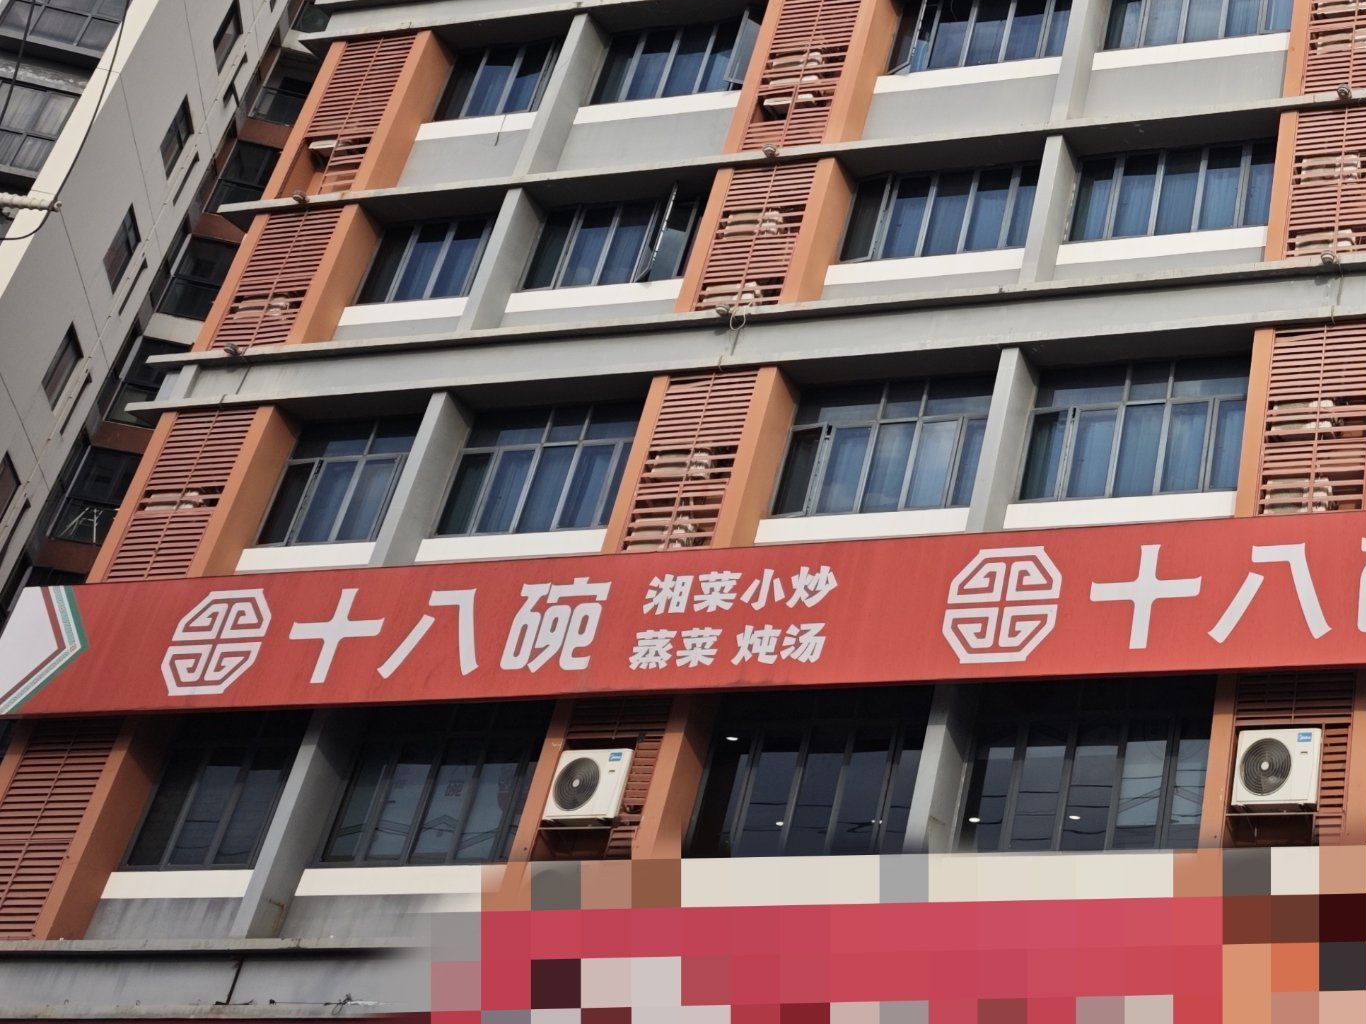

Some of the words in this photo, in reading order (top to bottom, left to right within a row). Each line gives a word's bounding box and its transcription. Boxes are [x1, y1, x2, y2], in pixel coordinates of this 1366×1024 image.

[643, 565, 839, 617] 湘菜小炒
[289, 577, 613, 685] 十八碗
[629, 626, 720, 671] 蒸菜
[731, 623, 827, 667] 炖汤
